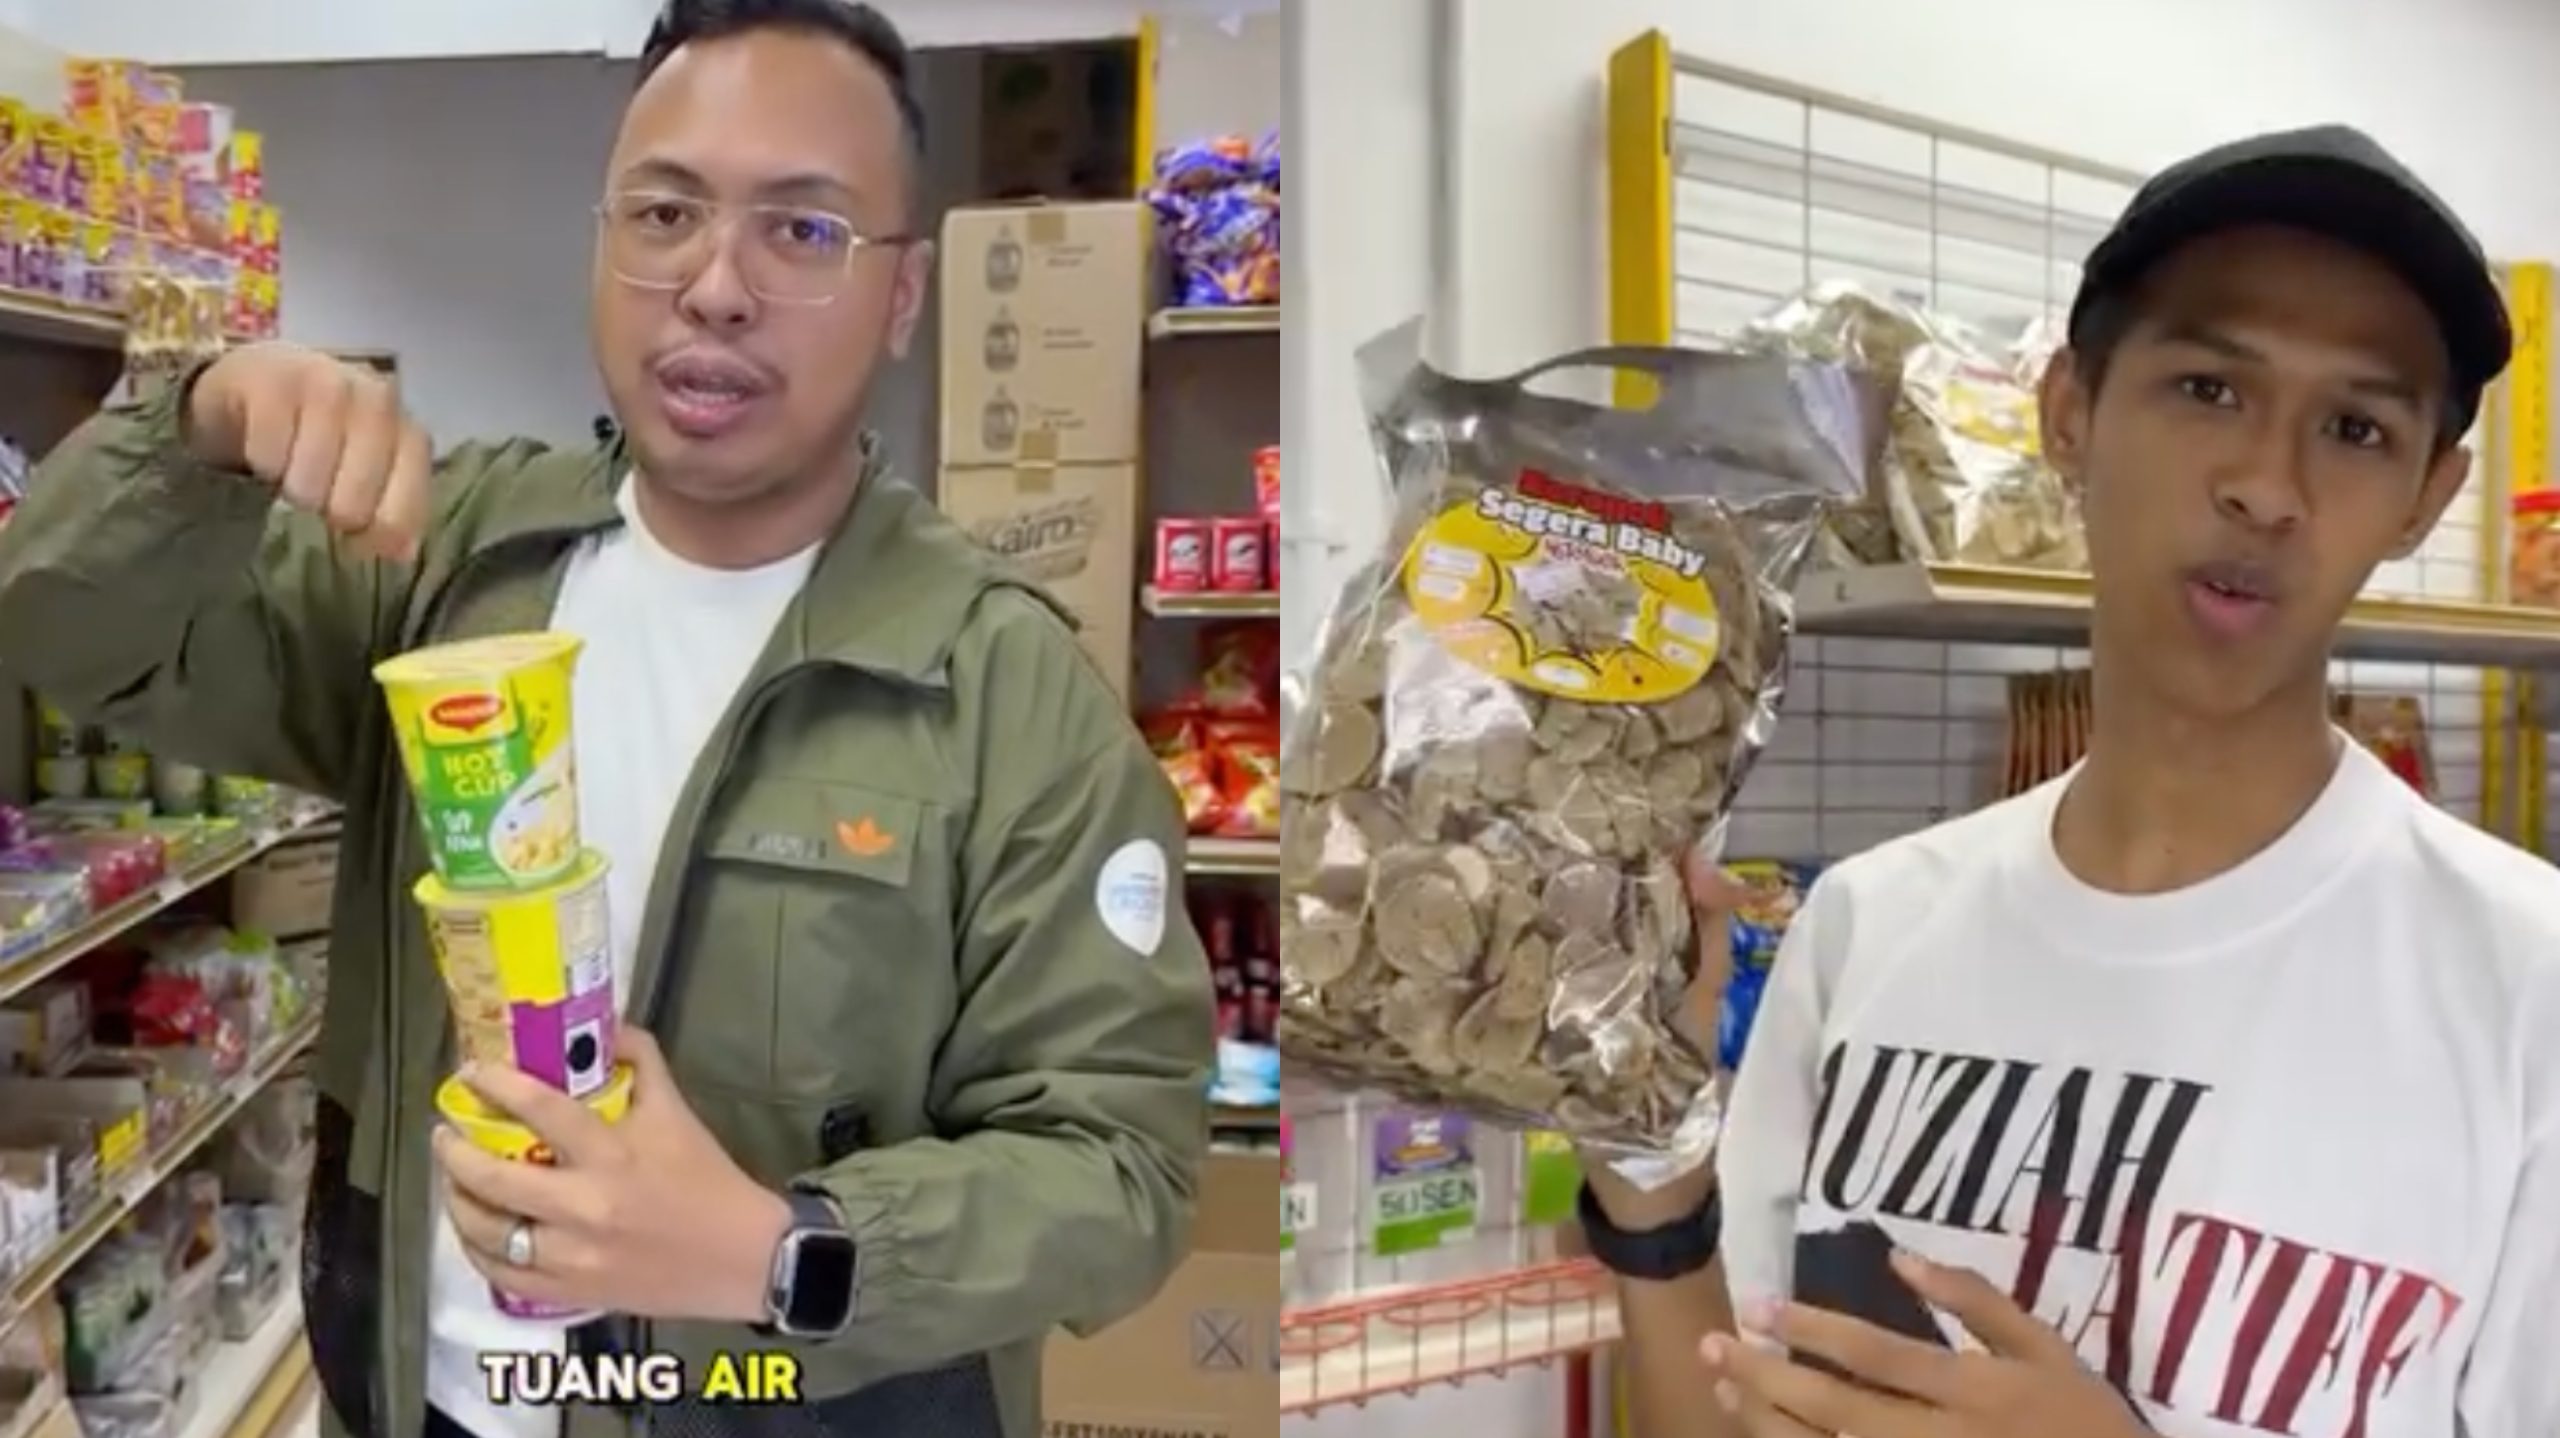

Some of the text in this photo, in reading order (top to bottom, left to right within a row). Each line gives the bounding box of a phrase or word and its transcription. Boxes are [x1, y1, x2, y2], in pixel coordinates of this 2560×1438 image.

[1478, 487, 1608, 545] Segera
[1616, 524, 1704, 579] Baby
[453, 771, 517, 799] CUP
